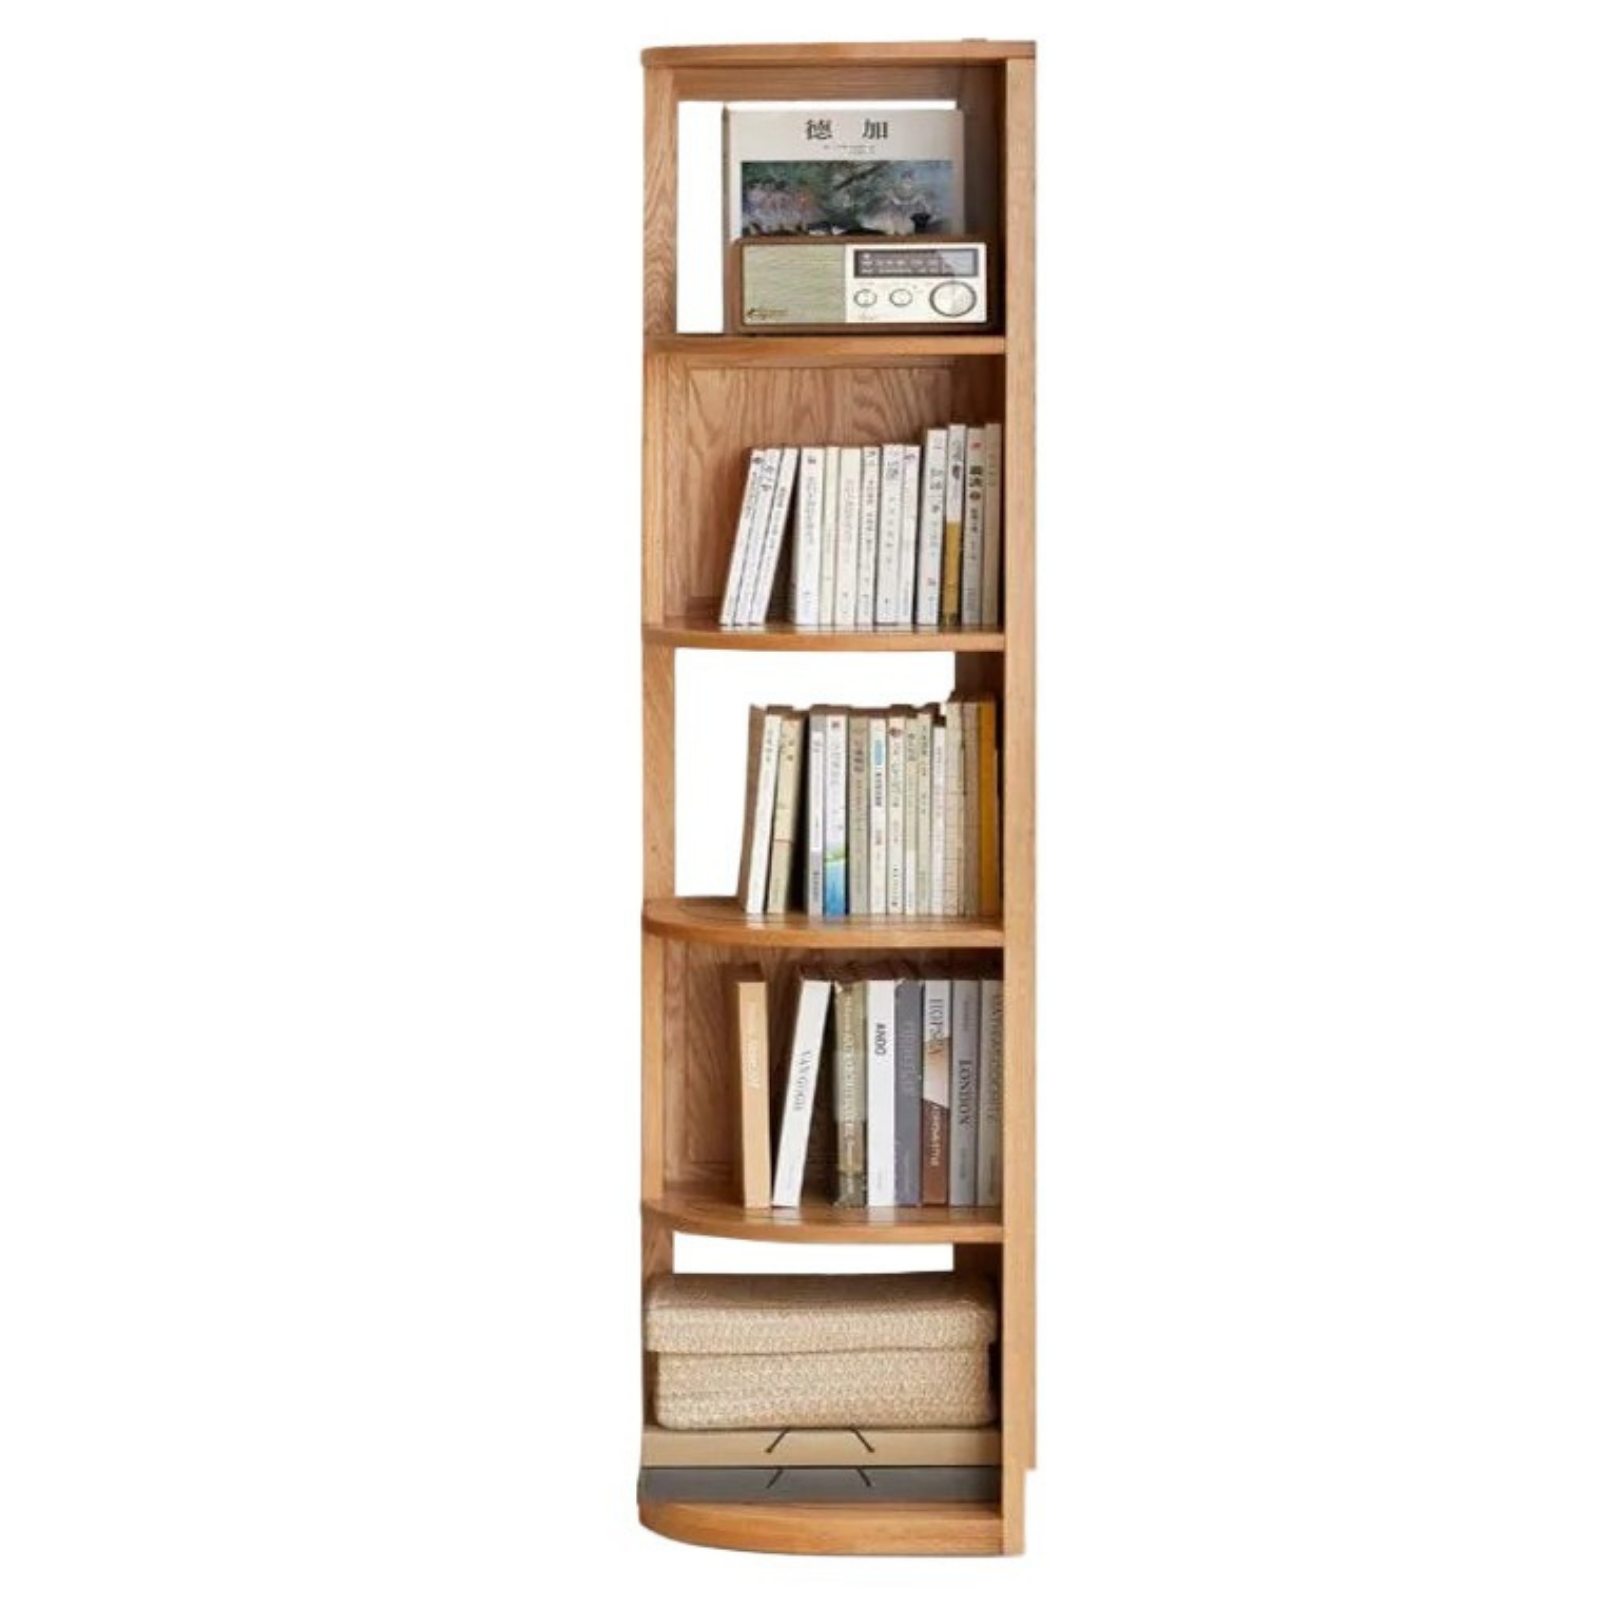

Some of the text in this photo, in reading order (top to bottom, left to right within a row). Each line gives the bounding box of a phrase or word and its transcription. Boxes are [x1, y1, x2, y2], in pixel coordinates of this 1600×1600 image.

[875, 1023, 888, 1055] ANDO
[793, 1050, 812, 1112] VAN GOGH
[958, 1059, 973, 1125] LONDON
